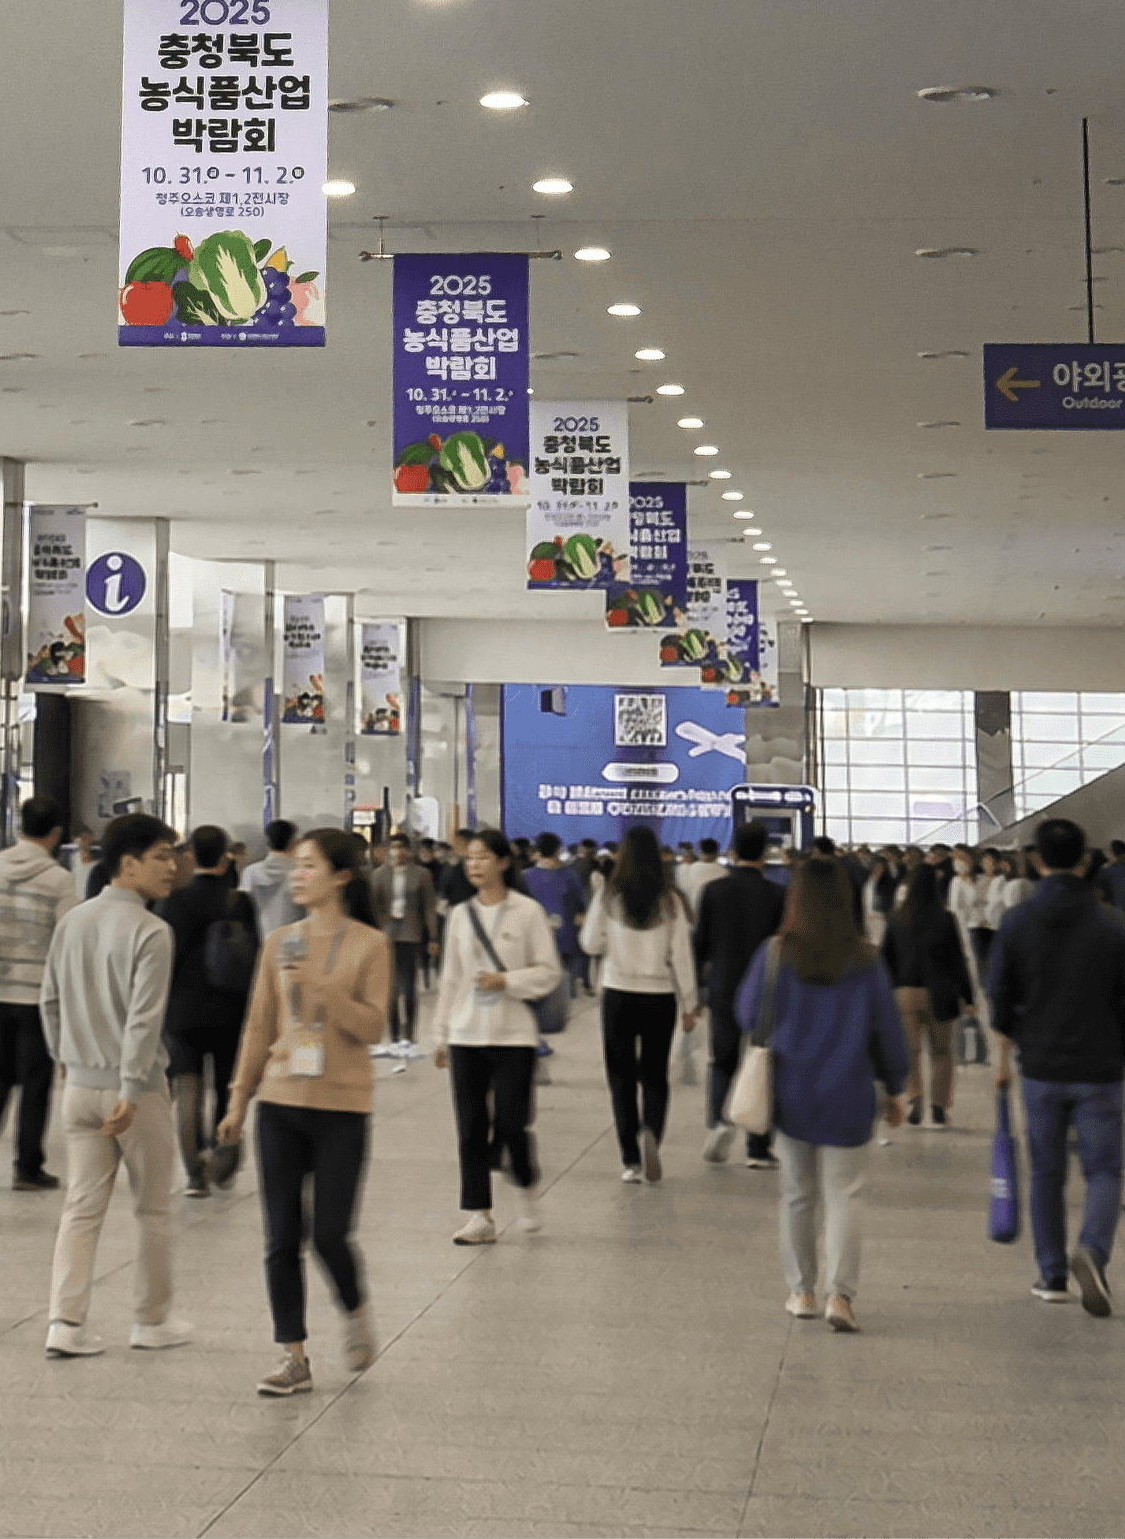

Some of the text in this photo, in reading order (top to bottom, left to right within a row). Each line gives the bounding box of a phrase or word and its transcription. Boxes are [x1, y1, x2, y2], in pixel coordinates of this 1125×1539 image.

[158, 32, 295, 70] 충청북도
[138, 74, 312, 112] 농식품산업
[172, 117, 276, 154] 박람회
[429, 274, 492, 295] 2025
[415, 299, 508, 325] 충청북도
[402, 327, 519, 353] 농식품산업
[425, 356, 497, 381] 박람회
[1061, 396, 1124, 410] Outdoor
[553, 416, 601, 433] 2025
